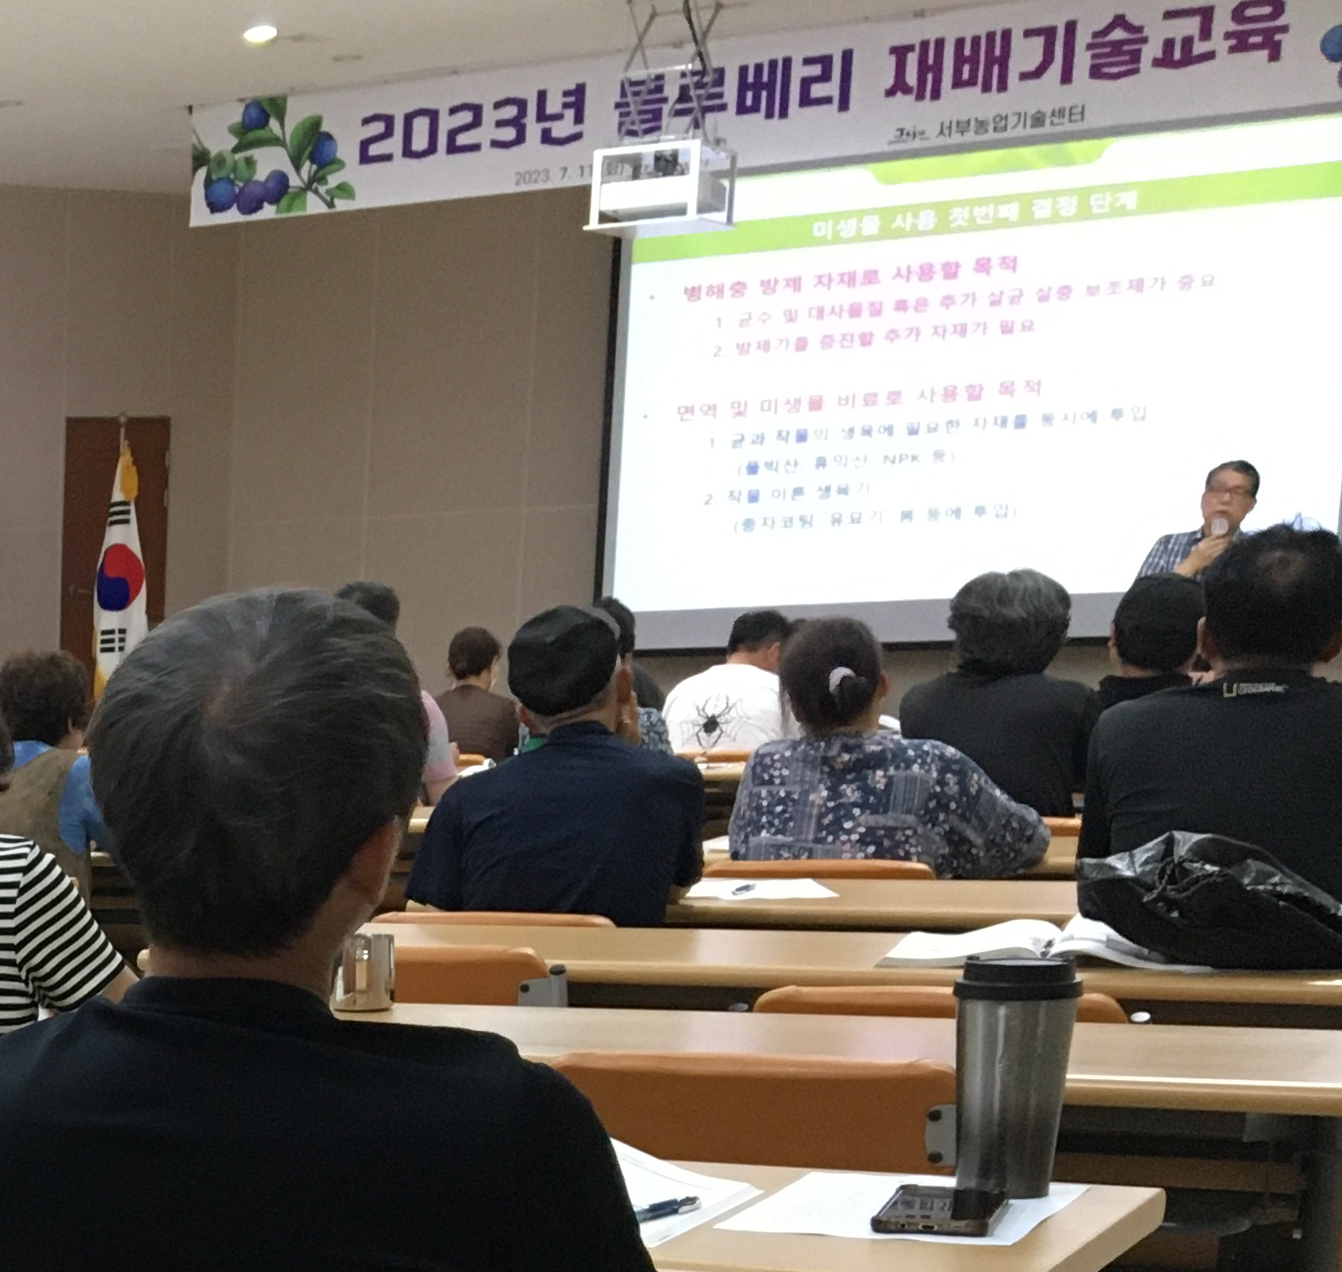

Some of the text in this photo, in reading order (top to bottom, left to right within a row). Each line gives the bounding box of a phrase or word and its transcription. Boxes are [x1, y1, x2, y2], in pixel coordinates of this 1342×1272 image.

[359, 0, 1290, 166] 2023년 블루베리 재배기술교육
[936, 104, 1086, 138] 서부농업기술센터
[812, 190, 1138, 240] 미생물 사용 첫번째 결정 단계
[759, 275, 803, 295] 방제
[813, 268, 881, 291] 자재로
[891, 260, 961, 284] 사용할
[972, 254, 1018, 276] 목적
[676, 402, 717, 422] 면역
[917, 382, 985, 404] 사용할
[998, 378, 1042, 399] 목적
[883, 453, 921, 466] NPK
